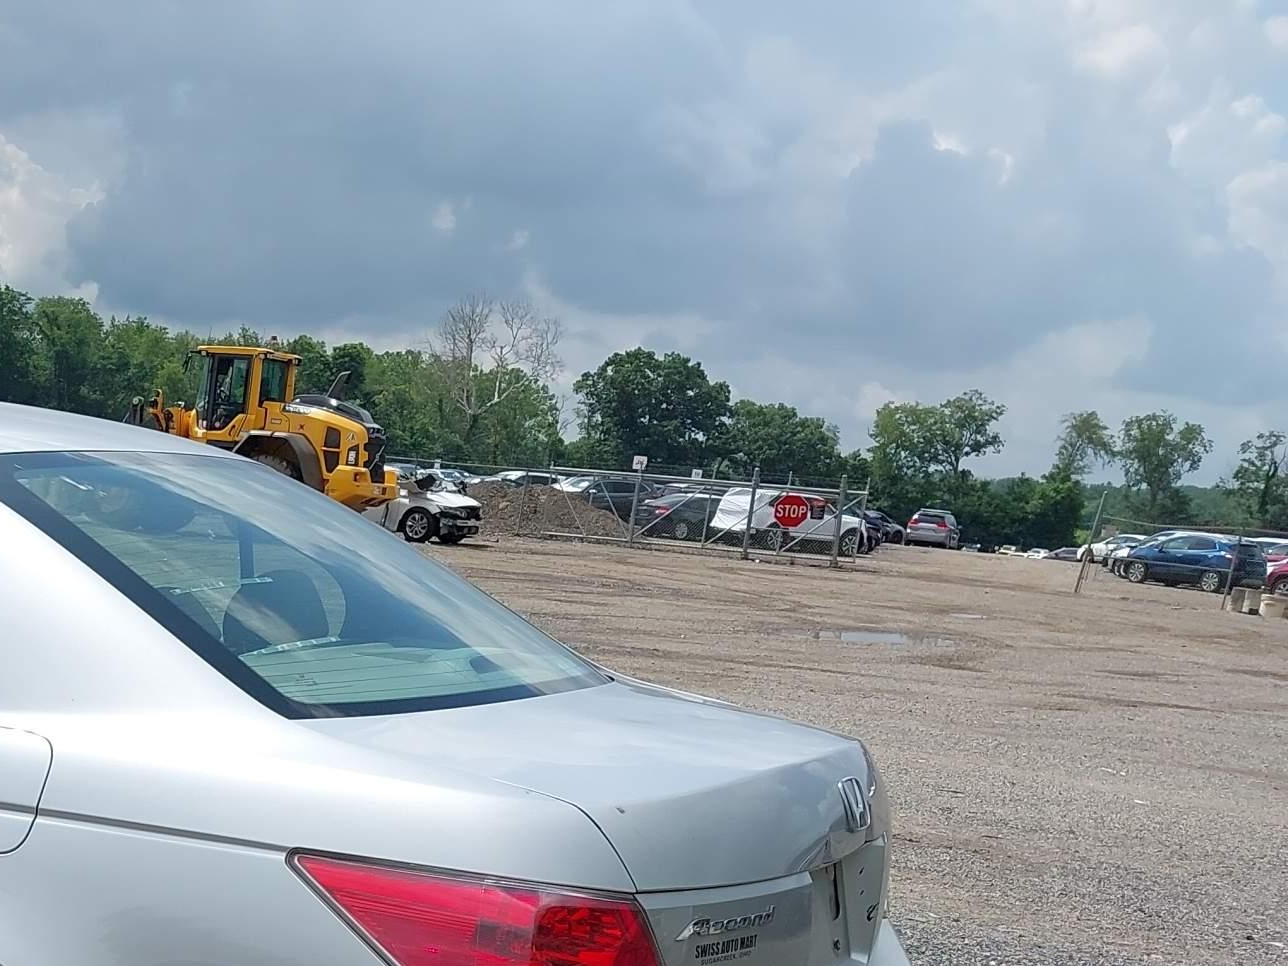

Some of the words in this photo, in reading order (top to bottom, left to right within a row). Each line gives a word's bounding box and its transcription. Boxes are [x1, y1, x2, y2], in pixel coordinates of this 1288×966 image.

[776, 504, 807, 518] STOP
[673, 904, 776, 942] Accord
[695, 940, 721, 959] SWISS
[721, 938, 739, 955] AUTO
[739, 934, 758, 951] MART
